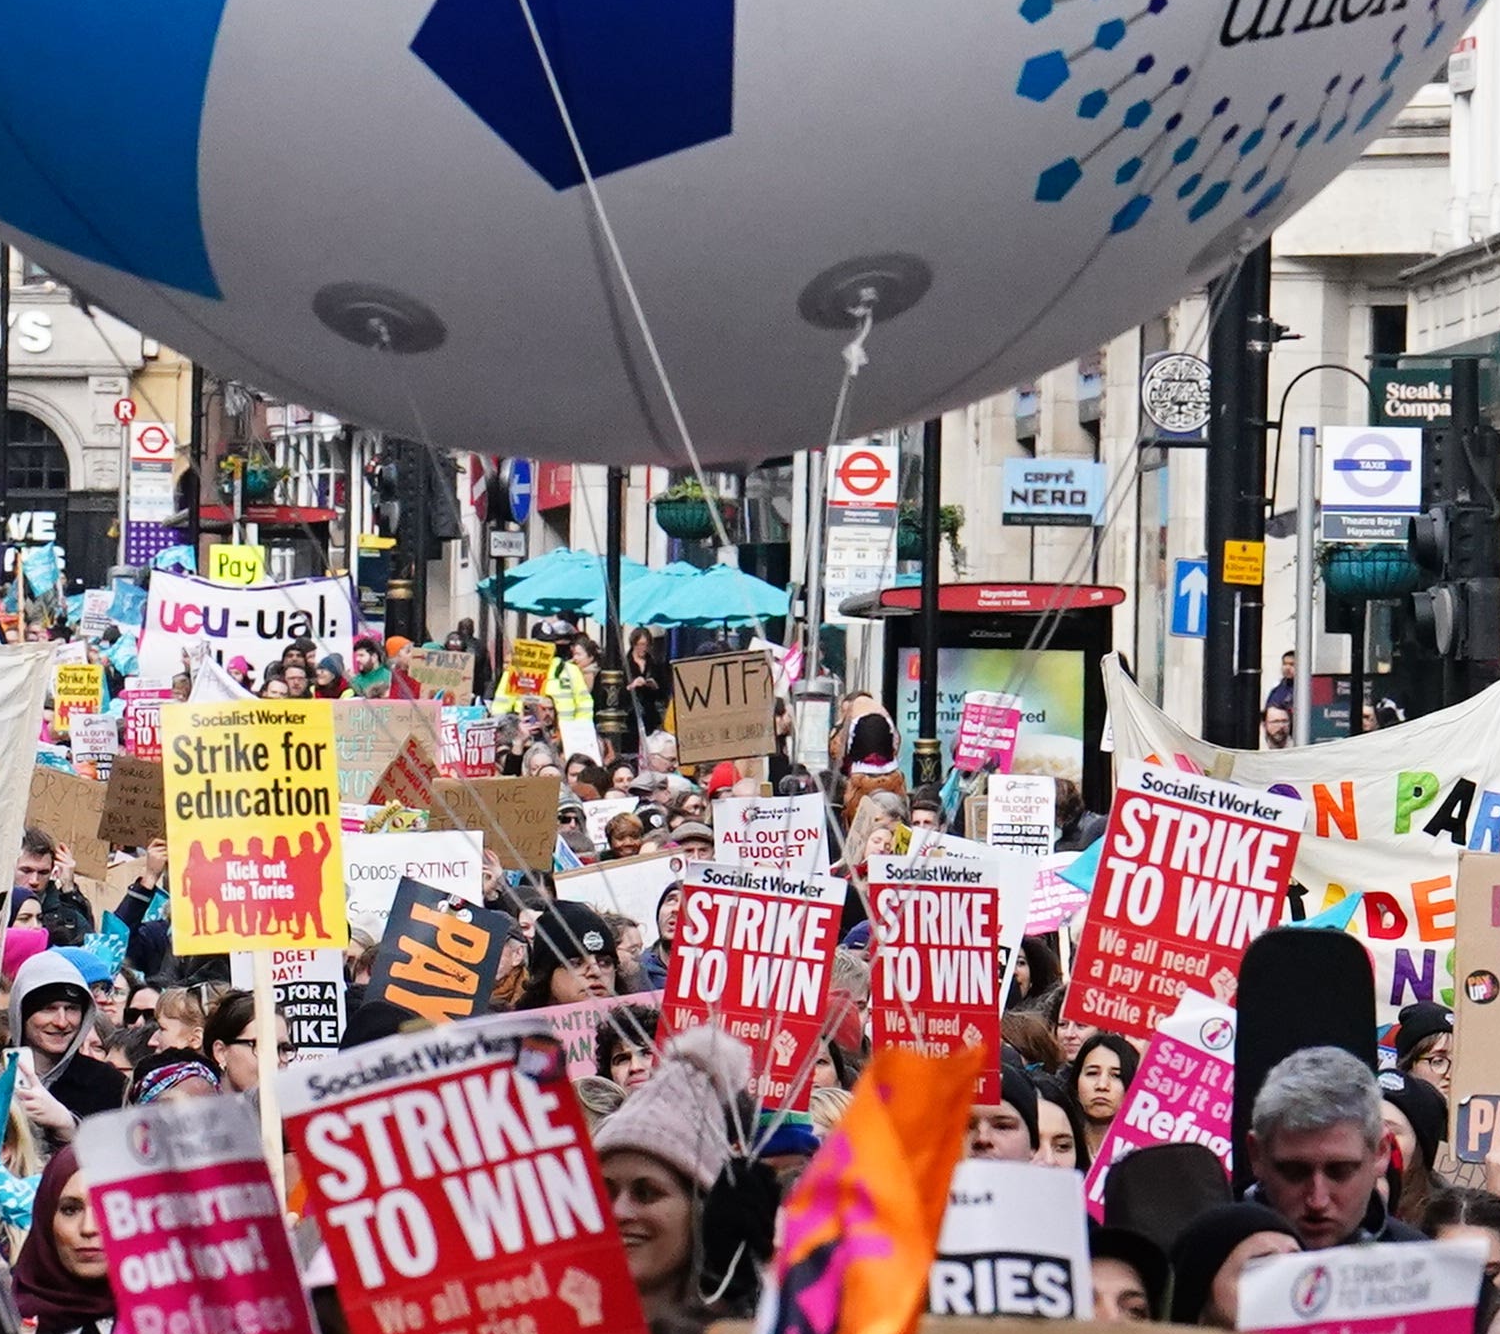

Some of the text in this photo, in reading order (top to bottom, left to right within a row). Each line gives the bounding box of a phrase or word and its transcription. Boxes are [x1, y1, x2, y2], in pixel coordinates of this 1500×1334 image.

[119, 403, 132, 418] R
[1385, 401, 1452, 420] Compa
[1386, 382, 1439, 399] Steak
[1359, 460, 1386, 470] TAXIS
[1011, 488, 1086, 506] NERO
[1341, 517, 1401, 528] Theatre Royal
[1347, 527, 1395, 538] Haymarket
[218, 553, 257, 584] Pay
[159, 595, 337, 641] ucu-ual:
[675, 658, 772, 711] WTF?
[191, 711, 306, 728] Socialist Worker
[173, 732, 326, 775] Strike for
[176, 778, 330, 819] education
[994, 795, 1049, 805] ALL OUT ON
[1141, 771, 1283, 823] Socialist Worker
[1113, 797, 1288, 894] STRIKE
[226, 861, 288, 880] Kick out
[349, 861, 468, 879] DODOS EXTINCT
[221, 881, 294, 901] the Tories
[1103, 857, 1274, 952] TO WIN
[682, 893, 829, 956] STRIKE
[875, 889, 992, 948] STRIKE
[1099, 927, 1208, 979] We all need
[288, 985, 336, 1001] FOR A
[676, 946, 828, 1016] TO WIN
[876, 951, 994, 1006] TO WIN
[1091, 960, 1188, 1000] a pay rise
[302, 1064, 579, 1203] STRIKE
[328, 1147, 603, 1288] TO WIN
